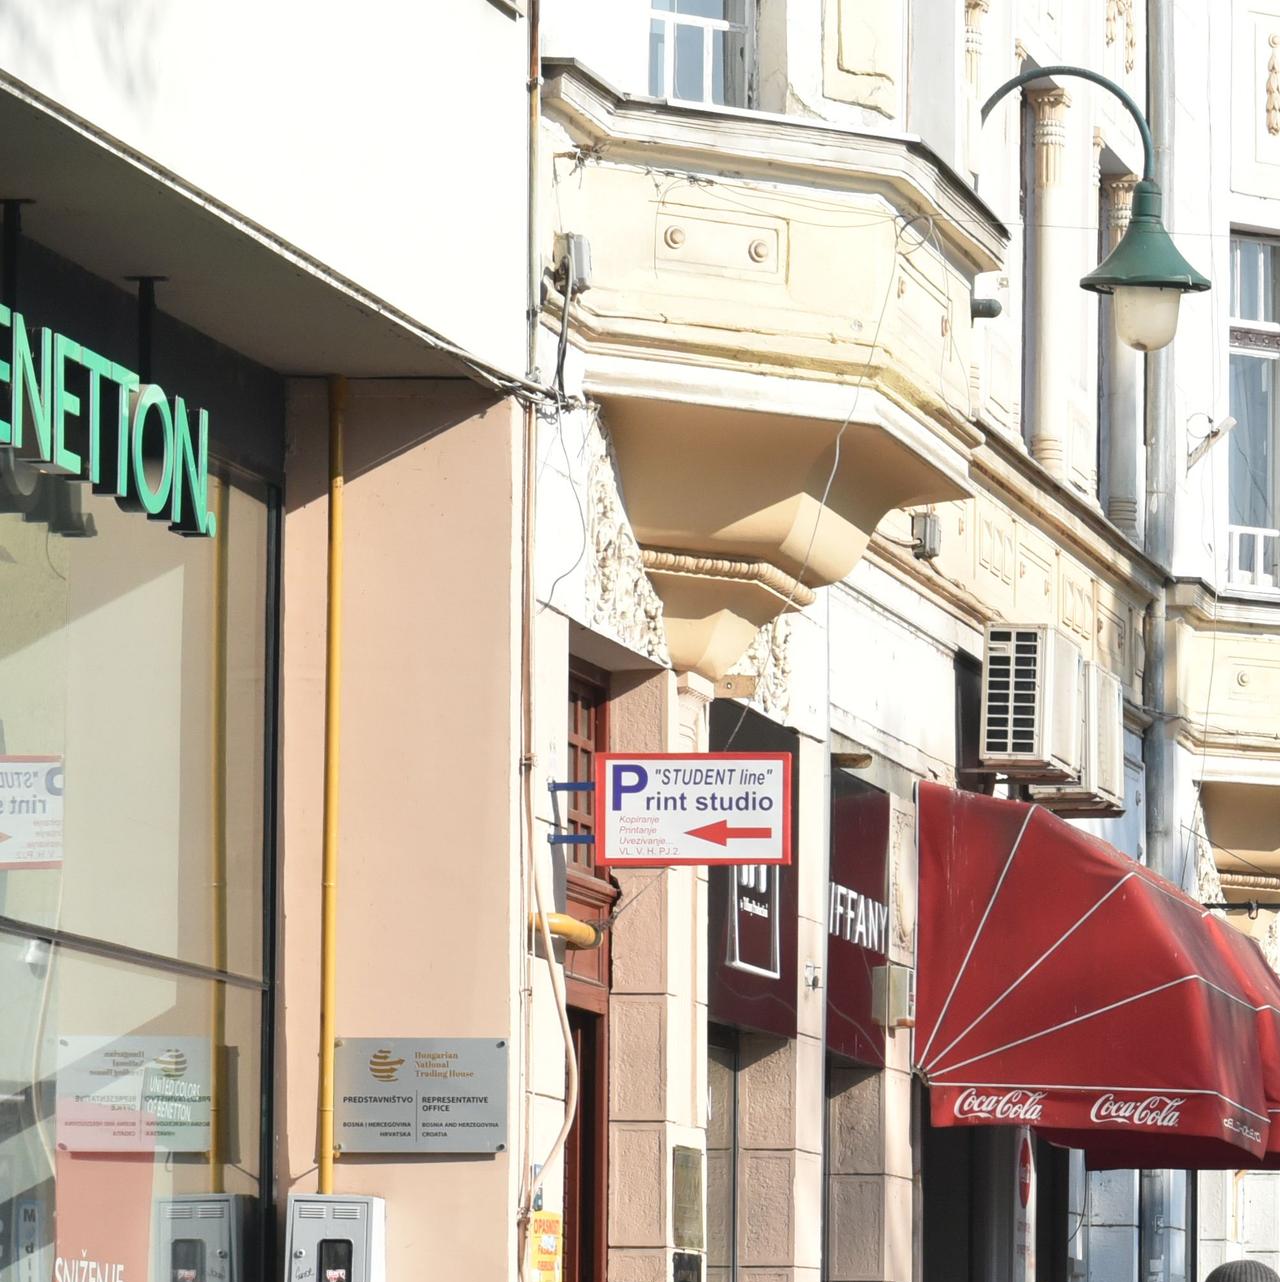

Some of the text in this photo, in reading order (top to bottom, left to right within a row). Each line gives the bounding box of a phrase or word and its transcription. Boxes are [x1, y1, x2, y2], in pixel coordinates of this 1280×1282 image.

[655, 768, 773, 785] "STUDENT line"
[695, 791, 774, 811] studio
[618, 815, 660, 825] Kopiranje
[618, 826, 657, 836] Printanje
[343, 1095, 413, 1104] PREDSTAVNIŠTVO
[421, 1096, 489, 1104] REPRESENTATIVE
[953, 1088, 1047, 1120] Coca-Cola
[422, 1104, 450, 1112] OFFICE
[1090, 1093, 1186, 1127] Coca-Cola
